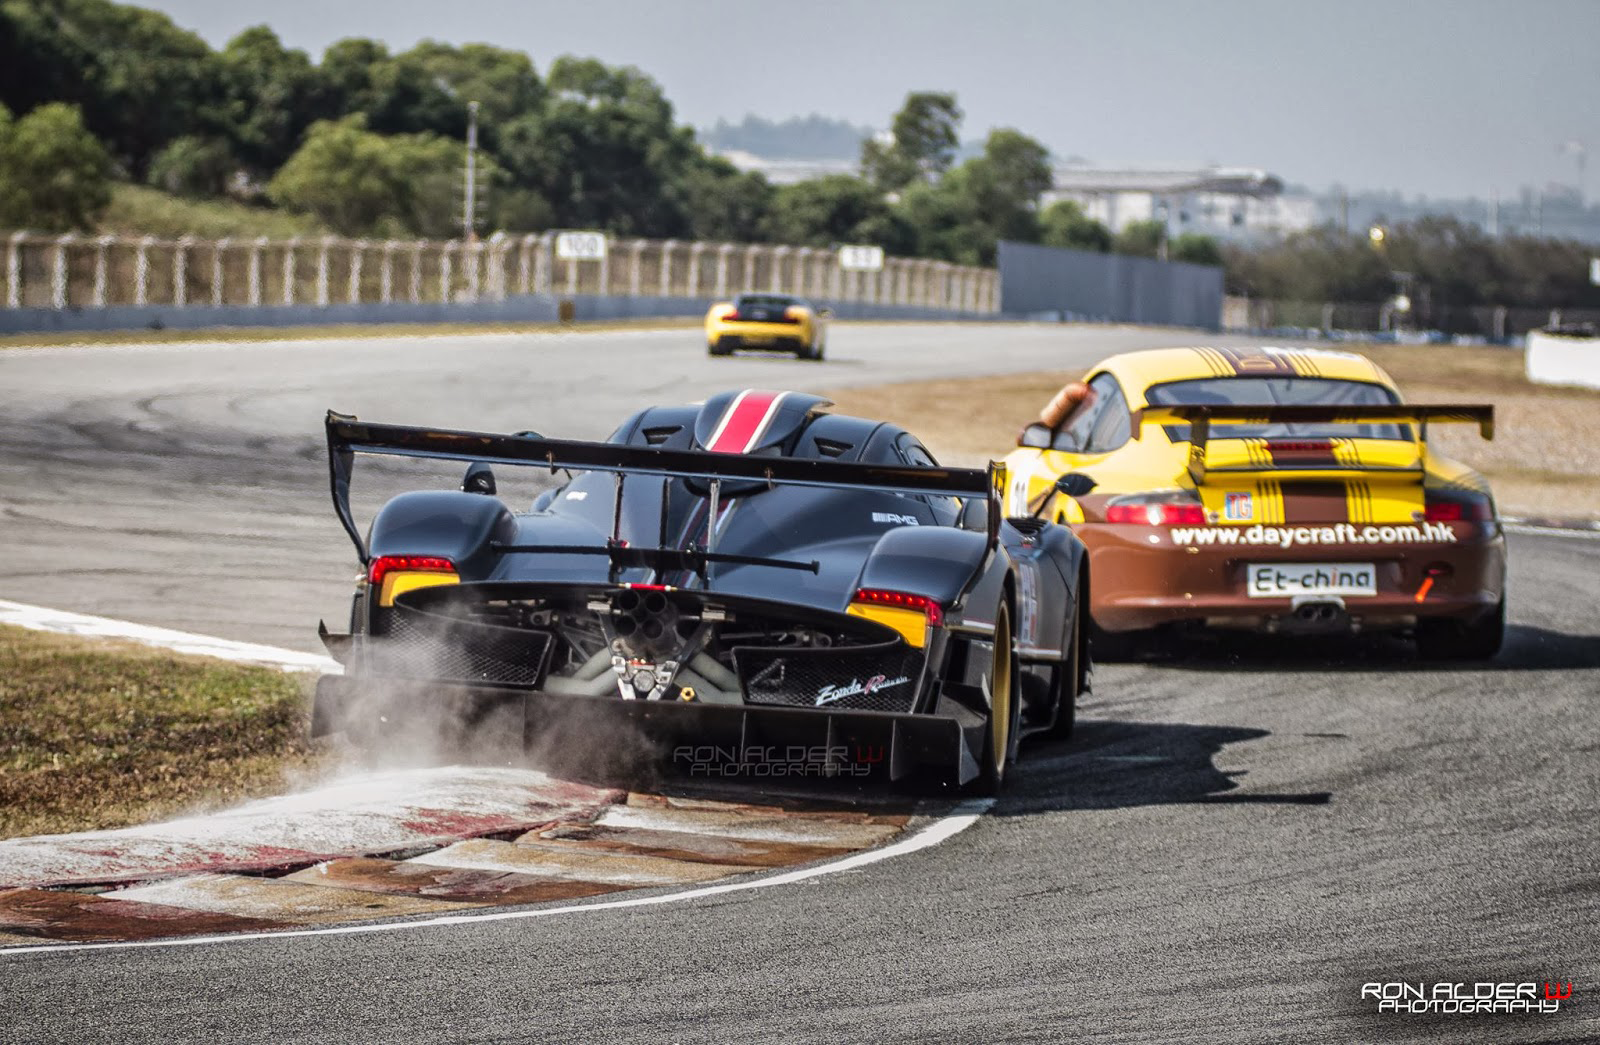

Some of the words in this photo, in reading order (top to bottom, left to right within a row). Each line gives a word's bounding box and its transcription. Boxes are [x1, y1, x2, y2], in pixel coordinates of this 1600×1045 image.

[887, 513, 920, 526] AMG
[1171, 522, 1456, 548] www.daycraft.com.hk
[1256, 567, 1370, 591] Et-china
